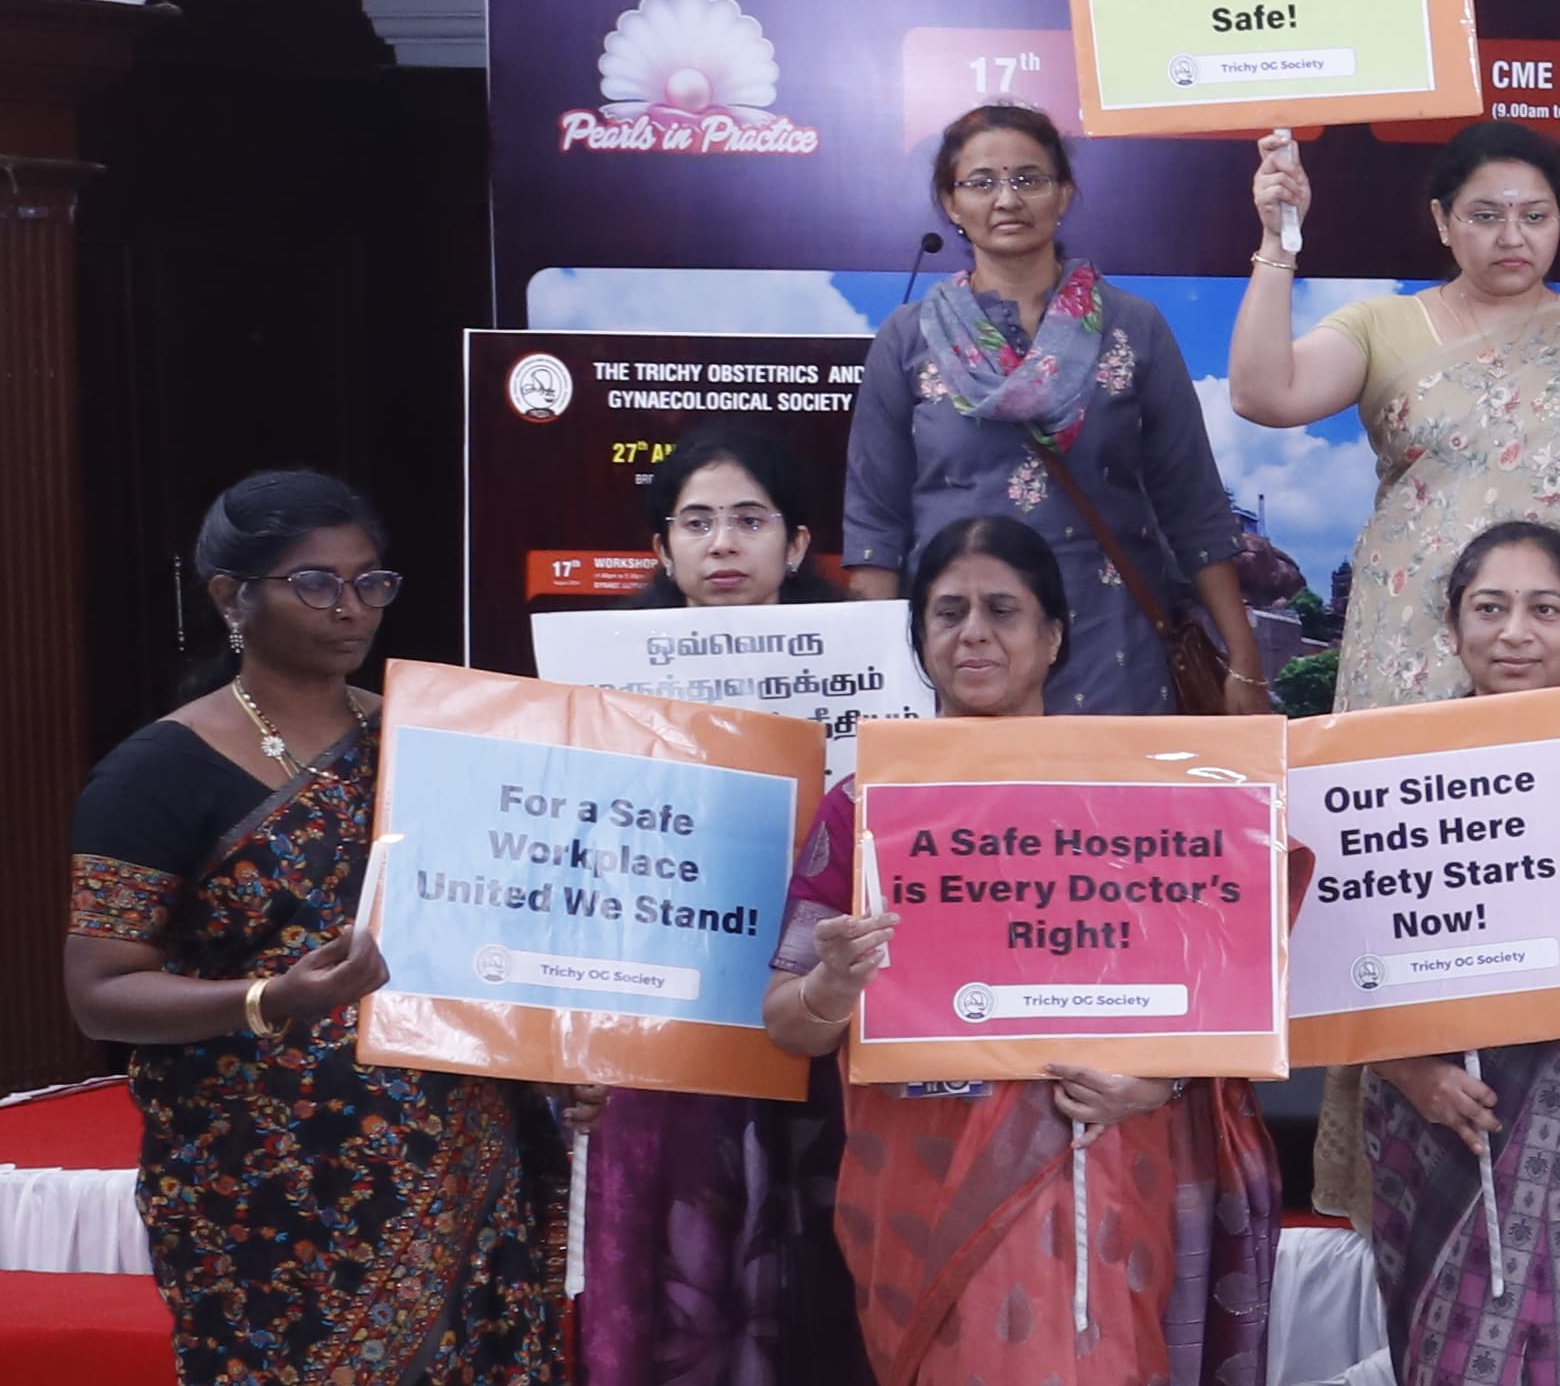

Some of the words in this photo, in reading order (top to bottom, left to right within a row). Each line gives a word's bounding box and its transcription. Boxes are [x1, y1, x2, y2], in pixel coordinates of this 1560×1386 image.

[1212, 4, 1297, 33] Safe!
[1221, 62, 1257, 74] Trichy
[1261, 60, 1278, 71] OG
[1281, 57, 1325, 71] Society
[562, 113, 657, 150] Pearls
[662, 121, 691, 150] in
[701, 115, 818, 153] Practice
[594, 363, 629, 380] THE
[635, 364, 702, 382] TRICHY
[708, 365, 819, 383] OBSTETRICS
[608, 390, 772, 410] GYNAECOLOGICAL
[777, 393, 852, 411] SOCIETY
[594, 558, 658, 569] WORKSHOP
[1324, 786, 1389, 813] Our
[1399, 771, 1536, 805] Silence
[500, 785, 567, 818] For
[578, 797, 598, 823] a
[610, 799, 695, 836] Safe
[911, 830, 938, 857] A
[951, 827, 1041, 857] Safe
[1055, 829, 1224, 863] Hospital
[1341, 823, 1428, 856] Ends
[1440, 817, 1526, 845] Here
[489, 830, 699, 883] Workplace
[893, 877, 927, 903] is
[941, 875, 1056, 909] Every
[1317, 870, 1433, 903] Safety
[1444, 855, 1556, 888] Starts
[418, 871, 552, 912] United
[564, 886, 623, 923] We
[635, 895, 759, 937] Stand!
[1393, 904, 1487, 939] Now!
[1008, 921, 1131, 955] Right!
[1024, 995, 1069, 1008] Trichy
[1072, 995, 1093, 1005] OG
[1097, 994, 1150, 1008] Society
